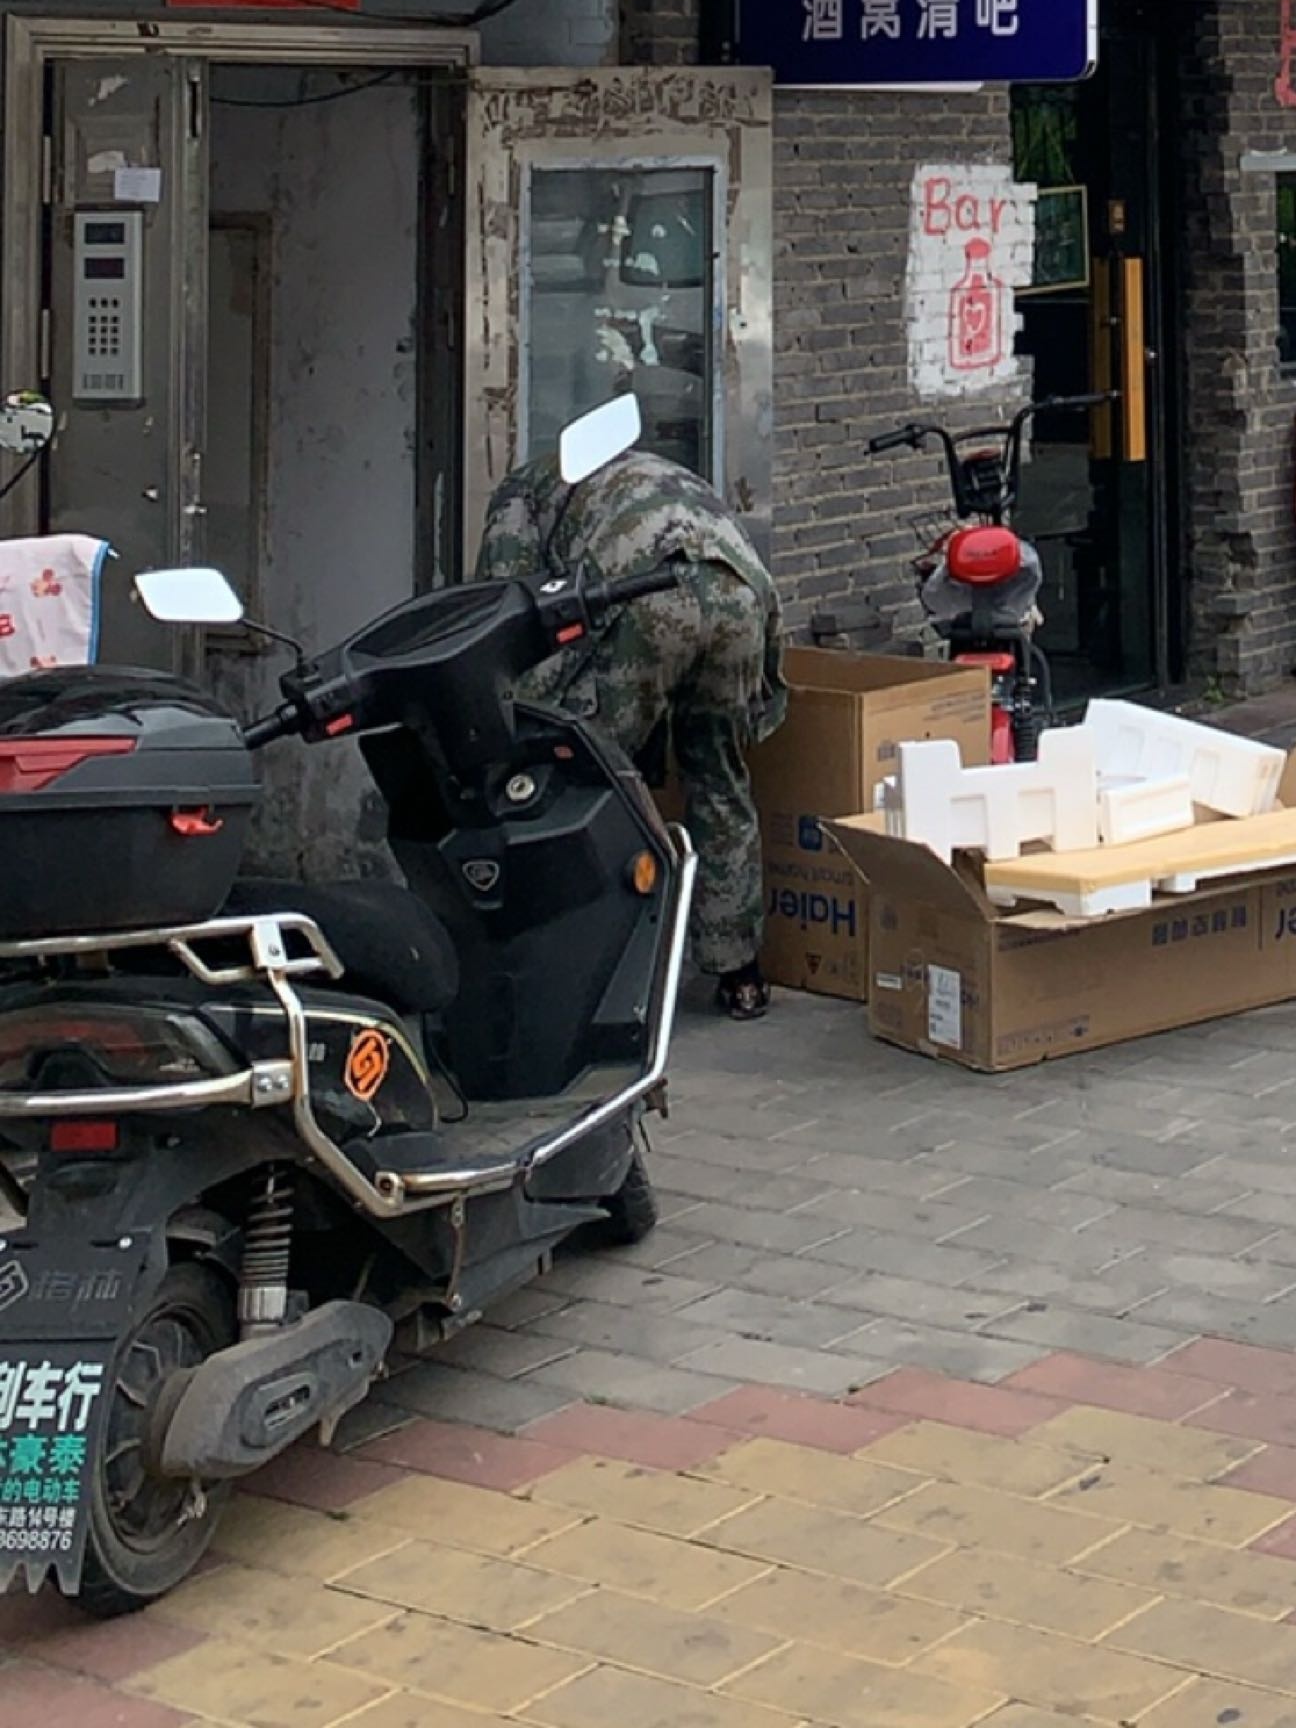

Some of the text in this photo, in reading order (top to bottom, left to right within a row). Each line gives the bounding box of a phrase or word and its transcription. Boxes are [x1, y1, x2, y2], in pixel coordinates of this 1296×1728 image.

[924, 177, 1006, 236] Bar
[768, 888, 856, 937] Haier
[0, 1476, 81, 1504] 的电动车
